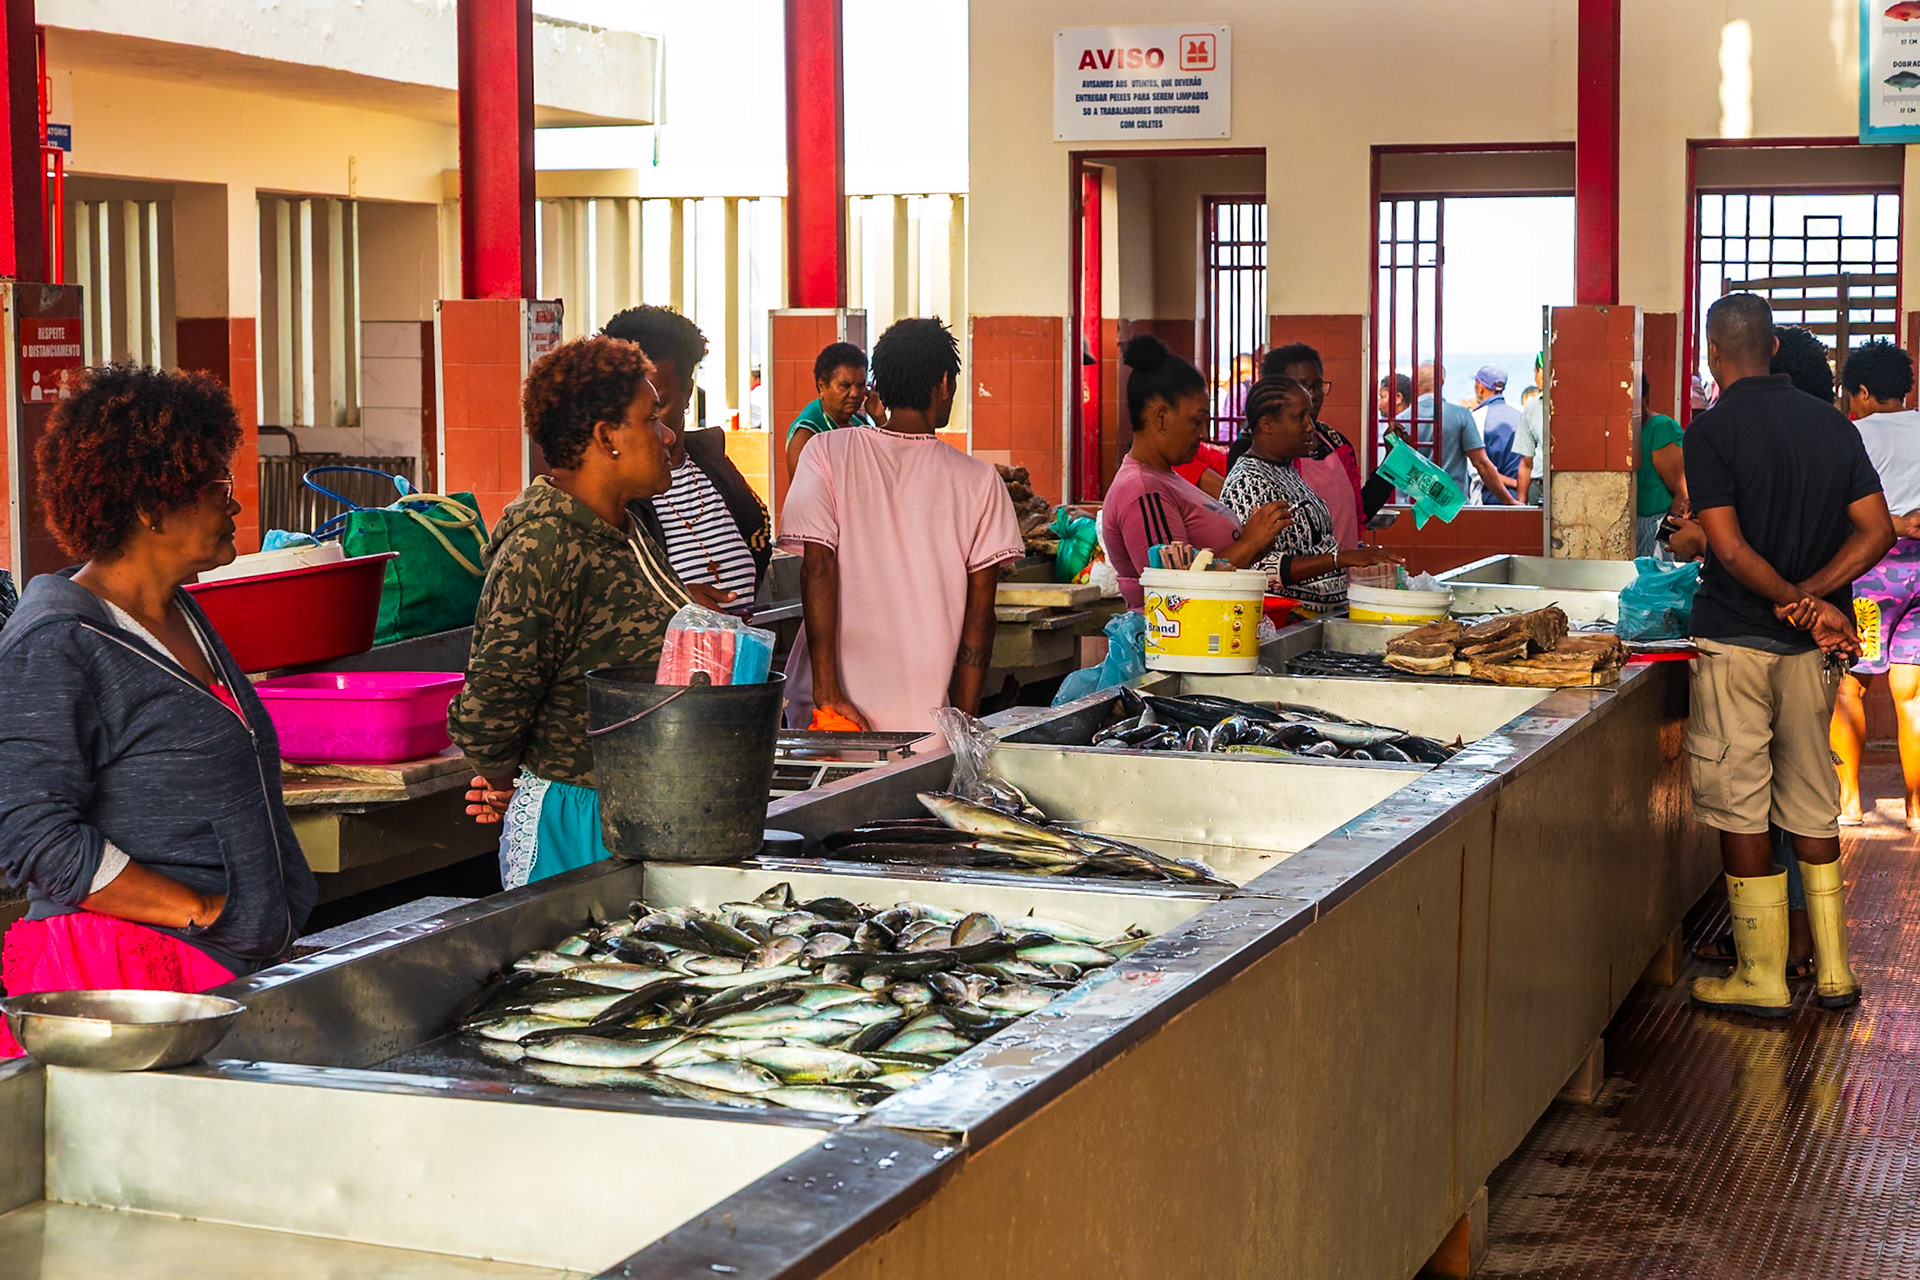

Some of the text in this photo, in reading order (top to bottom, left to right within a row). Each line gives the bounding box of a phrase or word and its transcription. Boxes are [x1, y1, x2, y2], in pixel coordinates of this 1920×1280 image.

[1078, 47, 1165, 70] AVISO
[1082, 76, 1202, 88] AVISAMOS AOS UTENTES, QUE DEVERÃO
[1075, 91, 1209, 102] ENTREGAR PEIXES PARA SEREM LIMPADOS
[1093, 107, 1099, 116] A
[1100, 106, 1152, 116] TRABALHADORES
[1153, 105, 1200, 115] IDENTIFICADOS
[1120, 119, 1163, 129] COM COLETES
[37, 327, 65, 340] RESPEITE
[22, 343, 81, 358] O DISTANCIAMENTO
[1148, 622, 1176, 633] Brand
